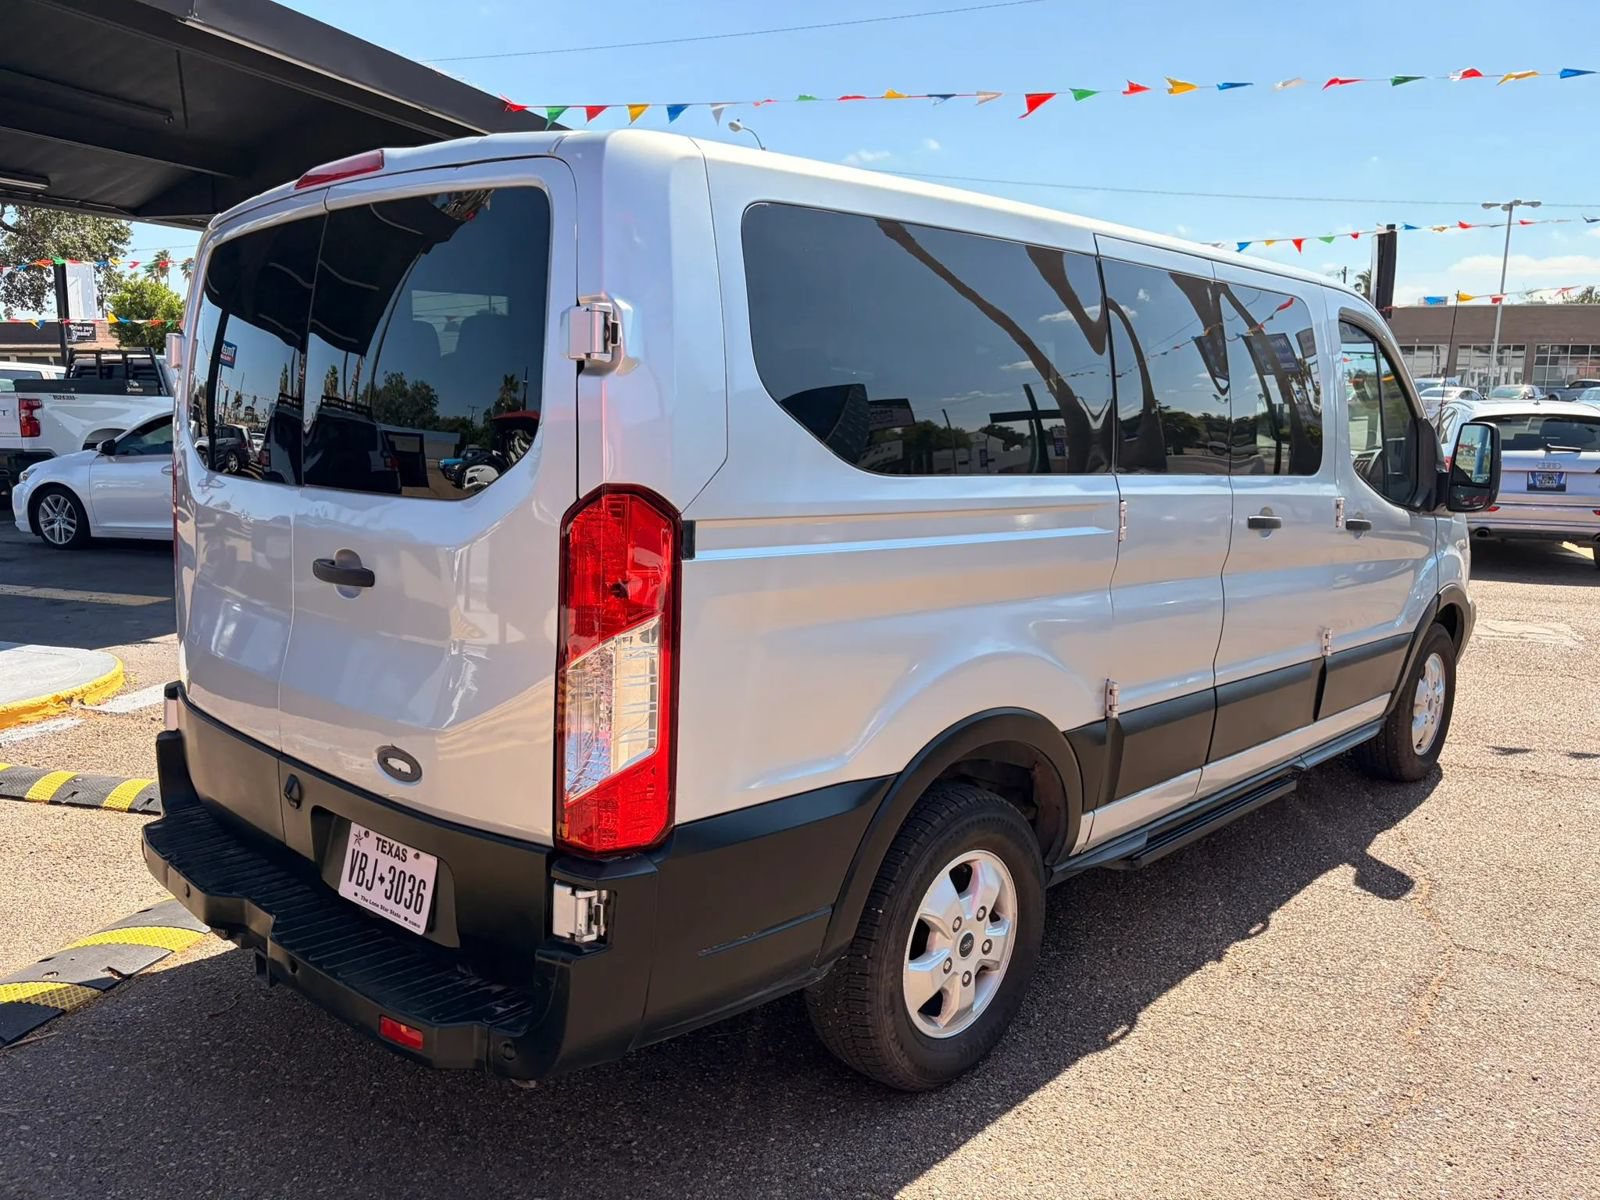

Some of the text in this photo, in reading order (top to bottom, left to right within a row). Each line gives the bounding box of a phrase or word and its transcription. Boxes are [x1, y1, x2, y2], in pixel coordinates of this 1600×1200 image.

[375, 836, 408, 863] TEXAS
[348, 848, 426, 915] VBJ 3036
[361, 895, 401, 919] The Lone Star State
